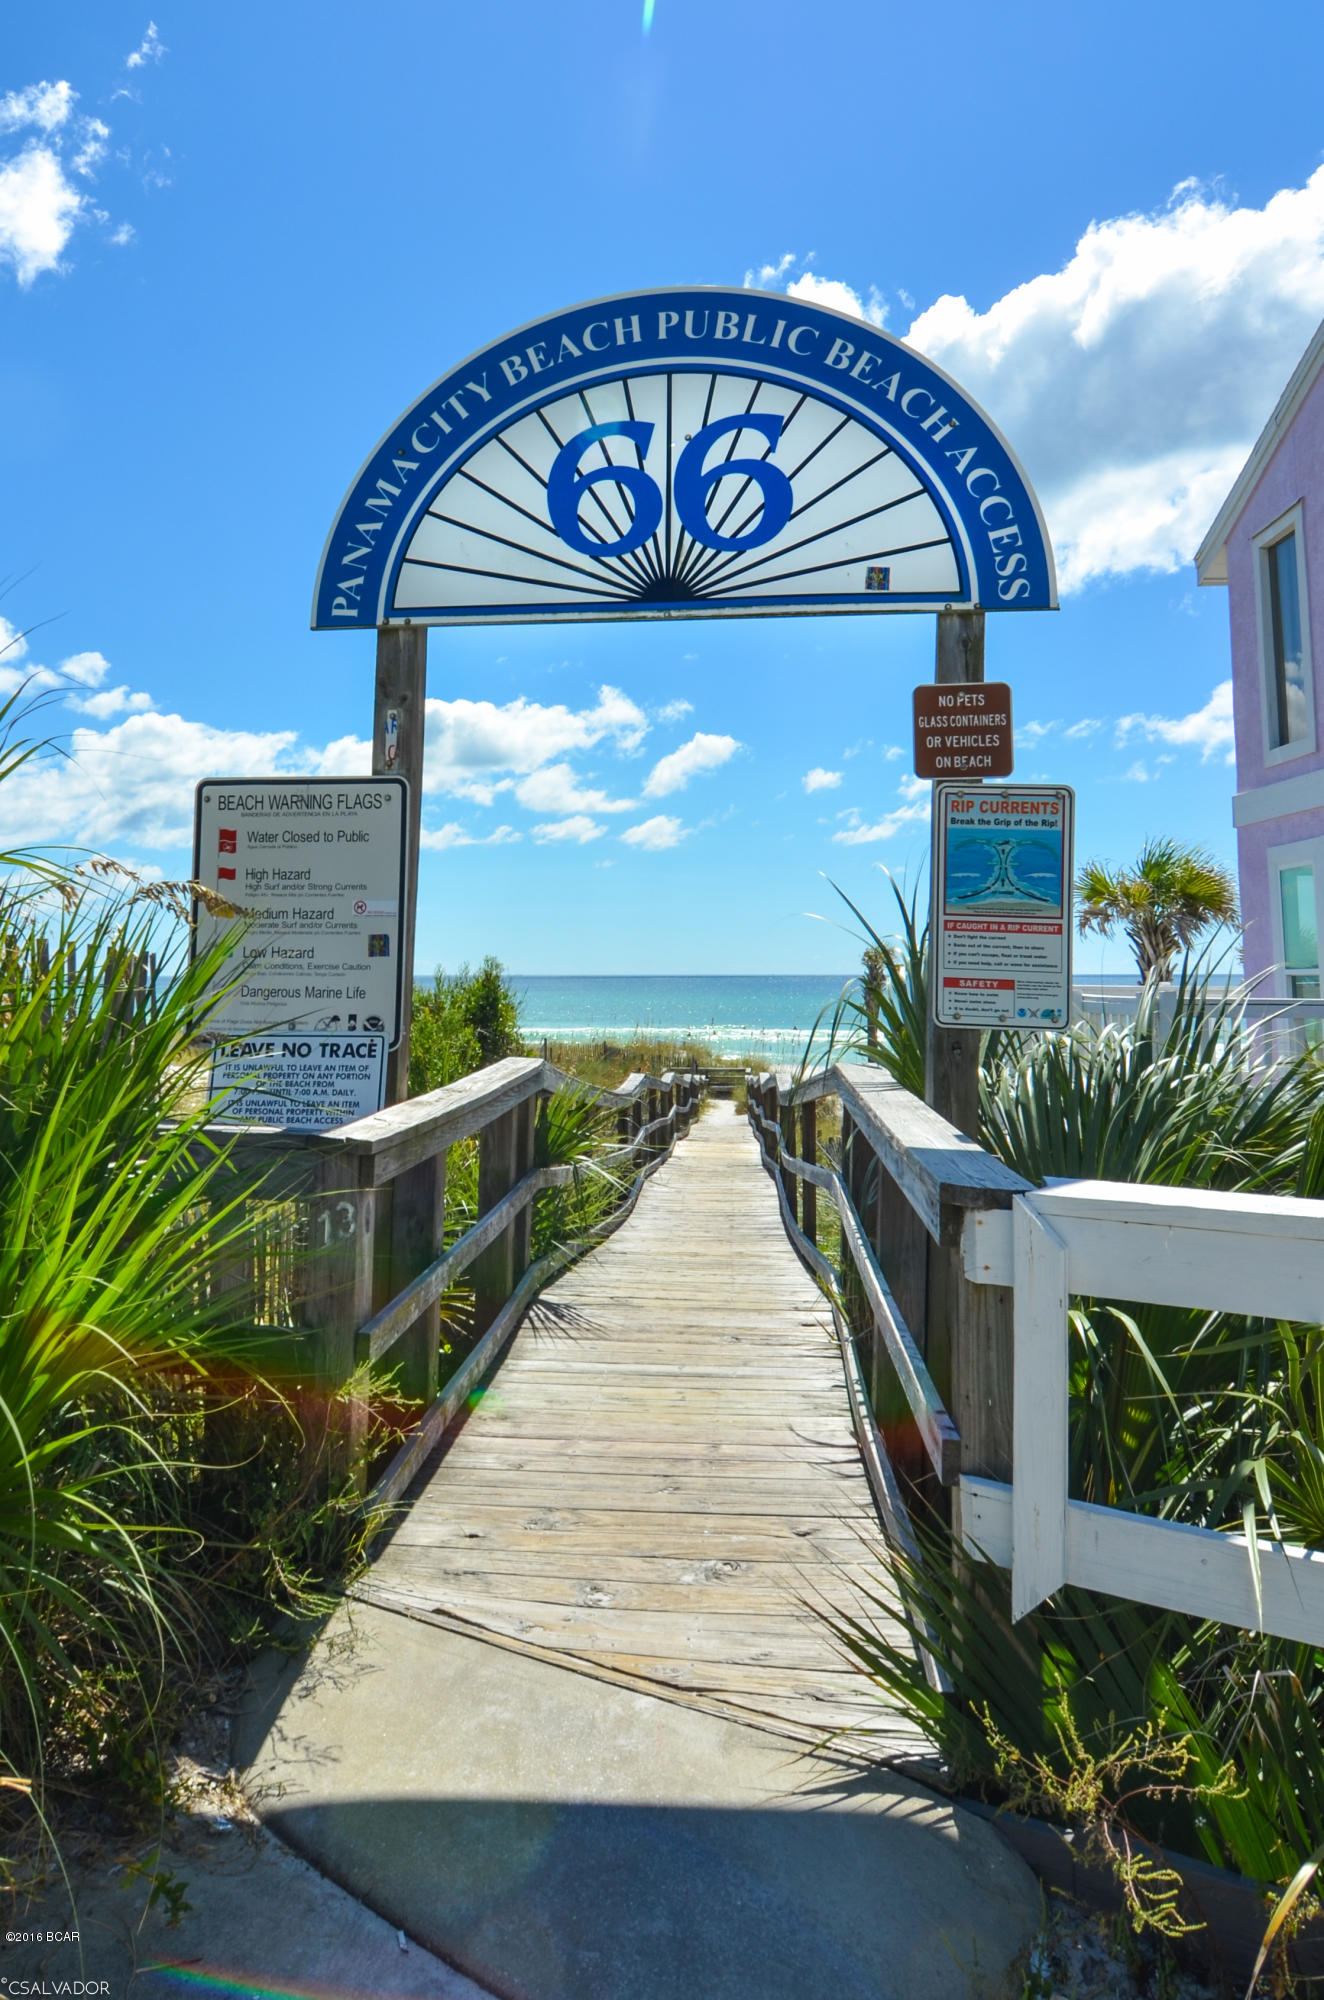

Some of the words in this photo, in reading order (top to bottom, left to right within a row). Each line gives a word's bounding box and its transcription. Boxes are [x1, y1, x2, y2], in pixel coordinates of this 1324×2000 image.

[331, 456, 420, 618] PANAMA
[411, 372, 492, 454] CITY
[499, 314, 642, 387] BEACH
[657, 310, 819, 356] PUBLIC
[824, 338, 959, 443] BEACH
[945, 446, 1031, 601] ACCESS
[547, 413, 793, 557] 66
[939, 696, 954, 707] NO
[957, 694, 985, 706] PETS
[919, 715, 948, 728] GLASS
[950, 714, 1006, 727] CONTAINERS
[926, 736, 942, 748] OR
[945, 735, 1000, 747] VEHICLES
[936, 757, 952, 768] ON
[954, 755, 991, 768] BEACH
[218, 795, 264, 811] BEACH
[269, 794, 332, 810] WARNING
[337, 794, 382, 809] FLAGS
[951, 800, 975, 813] RIP
[980, 801, 1059, 815] CURRENTS
[994, 818, 1011, 827] Grip
[1041, 819, 1057, 828] Rip!
[247, 831, 278, 843] Water
[282, 831, 320, 842] Closed
[324, 831, 333, 842] to
[337, 831, 369, 842] Public
[245, 869, 269, 883] High
[272, 869, 311, 880] Hazard
[245, 884, 262, 892] High
[308, 883, 332, 892] Strong
[292, 908, 334, 919] Hazard
[245, 921, 279, 929] derate
[325, 921, 358, 929] Currents
[243, 947, 267, 959] Low
[271, 947, 314, 958] Hazard
[264, 962, 304, 970] Conditions,
[959, 980, 999, 988] SAFETY
[241, 985, 301, 1000] Dangerous
[305, 986, 342, 998] Marine
[346, 986, 366, 999] Life
[221, 1043, 275, 1058] LEAVE
[282, 1043, 312, 1058] NO
[319, 1043, 377, 1058] TRACE
